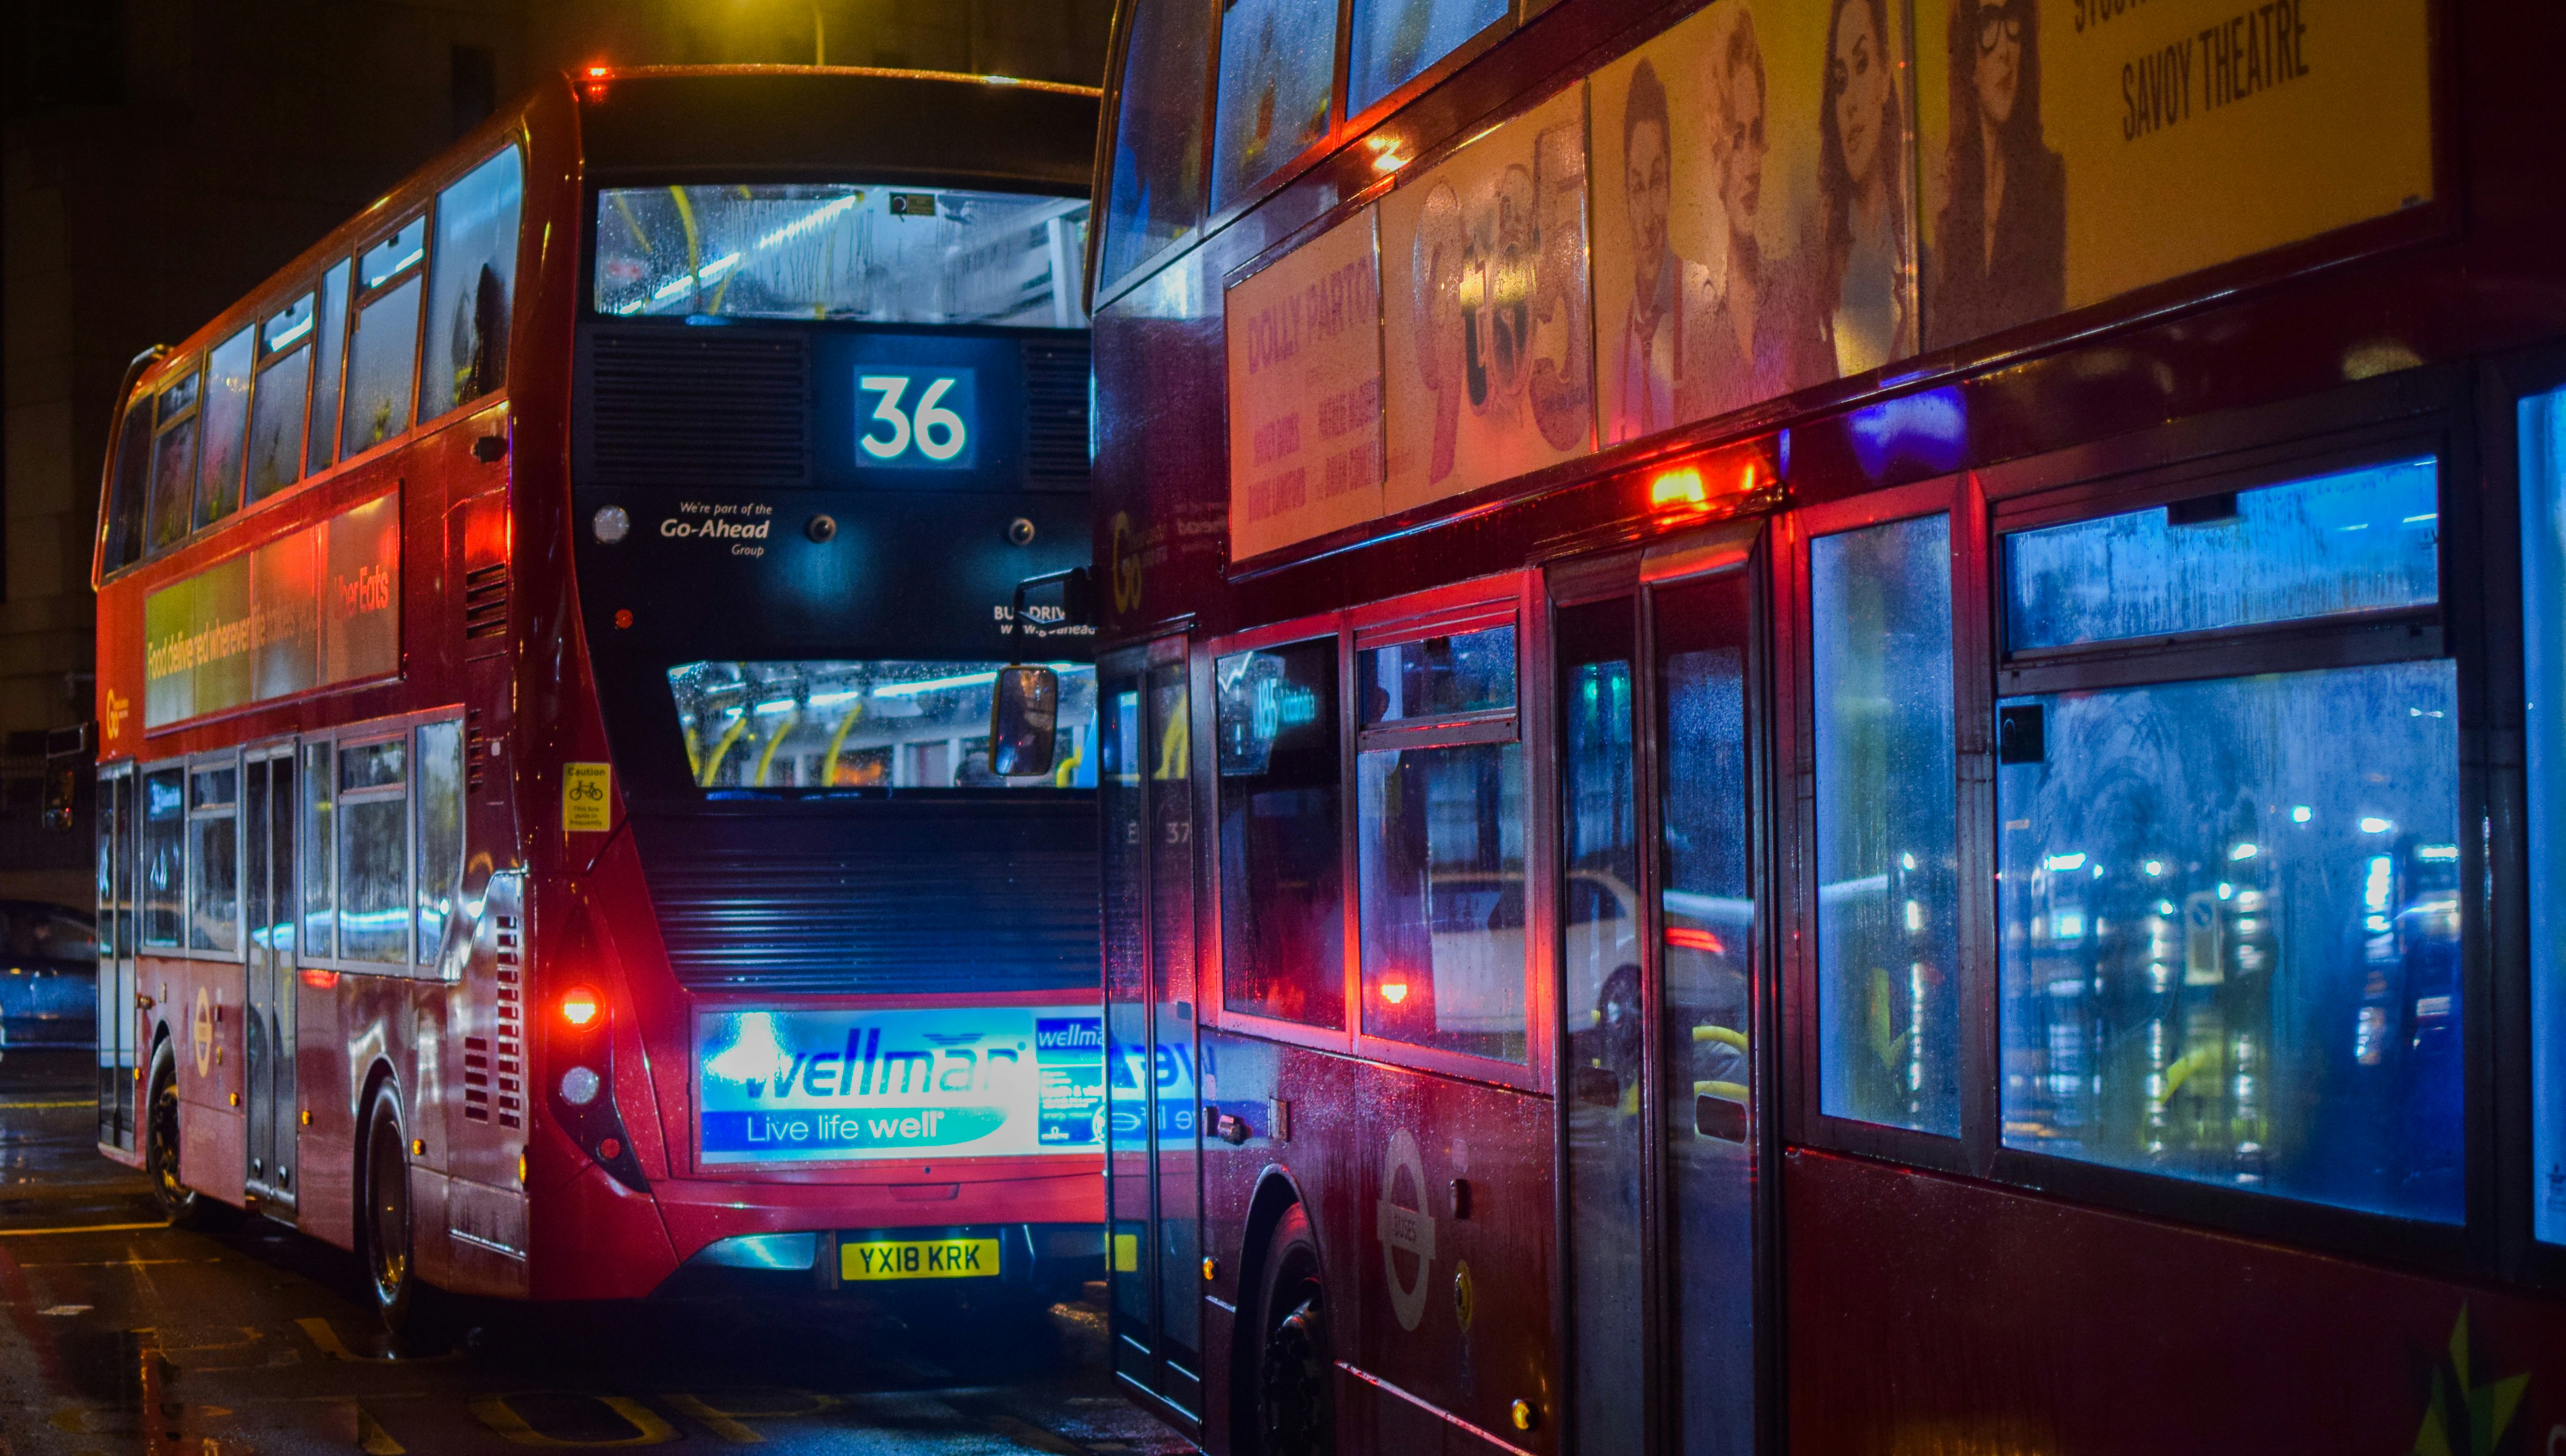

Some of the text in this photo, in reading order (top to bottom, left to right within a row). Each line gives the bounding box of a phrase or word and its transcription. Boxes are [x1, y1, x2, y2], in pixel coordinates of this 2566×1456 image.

[2122, 0, 2310, 141] SAVOY THEATRE
[1248, 291, 1301, 374] DOLLY
[861, 376, 966, 459] 36
[680, 502, 773, 517] We're part of the
[660, 518, 771, 538] Go-Ahead
[732, 543, 764, 559] Group
[359, 564, 389, 613] Eats
[994, 606, 1014, 621] BU
[148, 641, 167, 680] Food
[567, 766, 606, 777] Caution
[748, 1110, 937, 1141] Live life well
[860, 1244, 980, 1273] YX18 KRK
